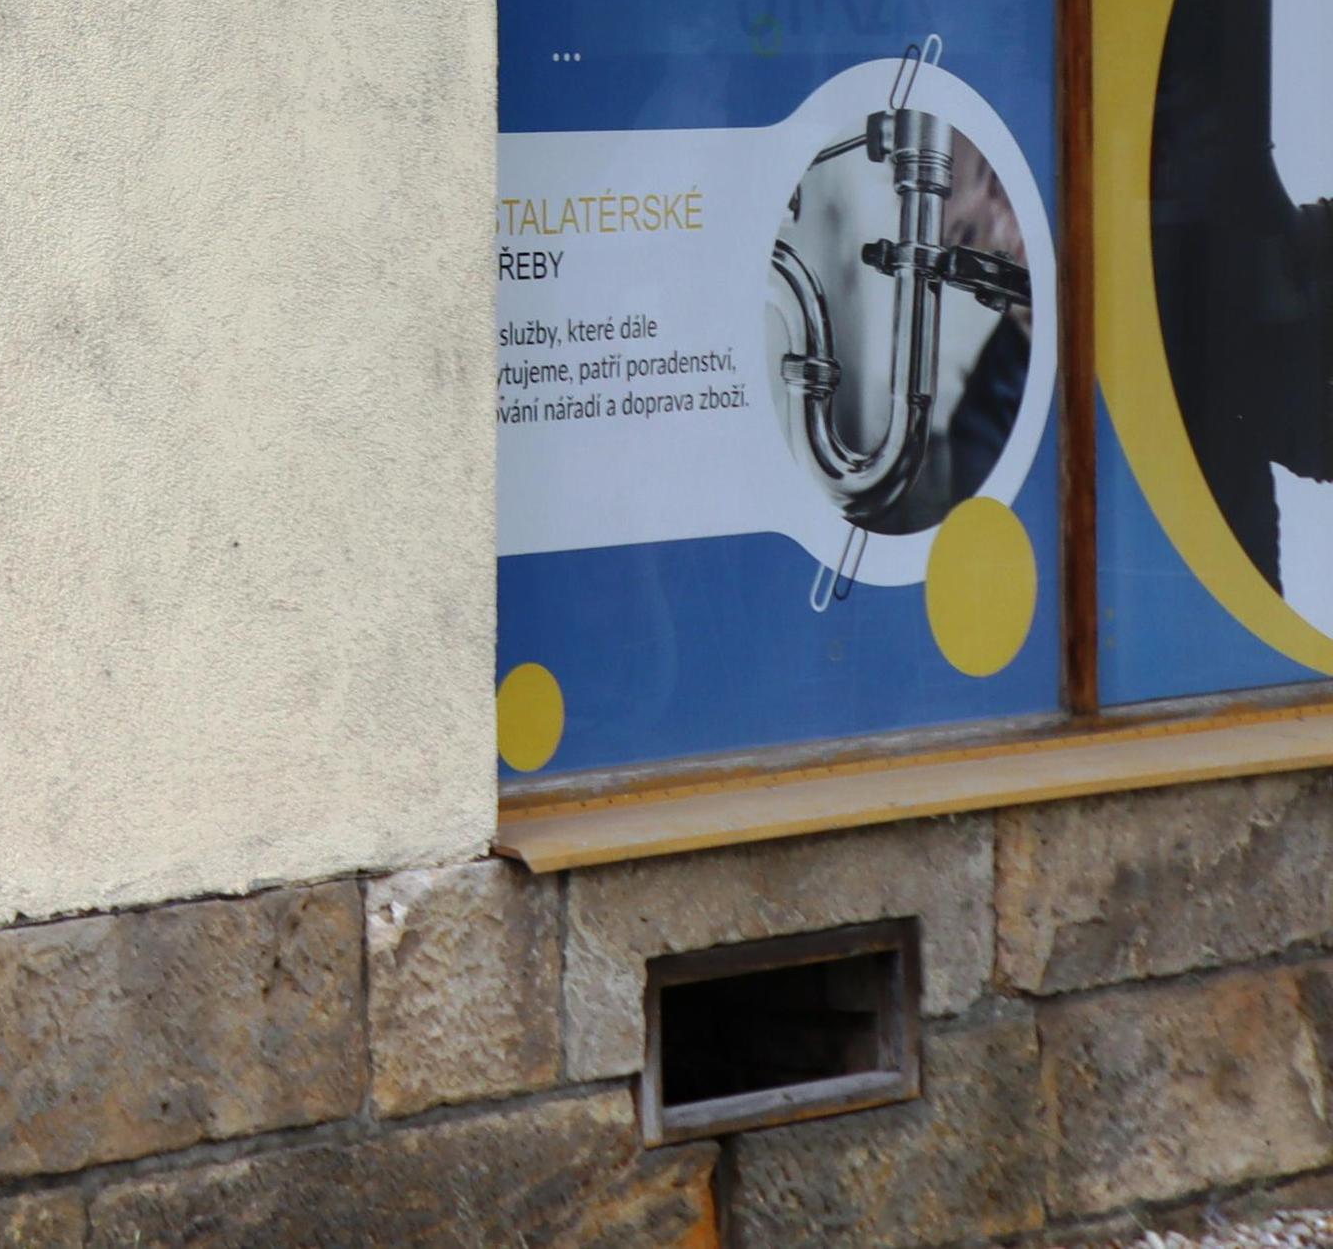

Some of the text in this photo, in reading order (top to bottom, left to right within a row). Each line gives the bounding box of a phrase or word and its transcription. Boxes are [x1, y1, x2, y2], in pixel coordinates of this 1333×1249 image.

[498, 246, 564, 280] ŘEBY
[500, 314, 657, 348] služby, které dále
[579, 353, 622, 384] patří
[626, 348, 736, 382] poradenství,
[497, 384, 749, 424] vání nářadí a doprava zboží.
